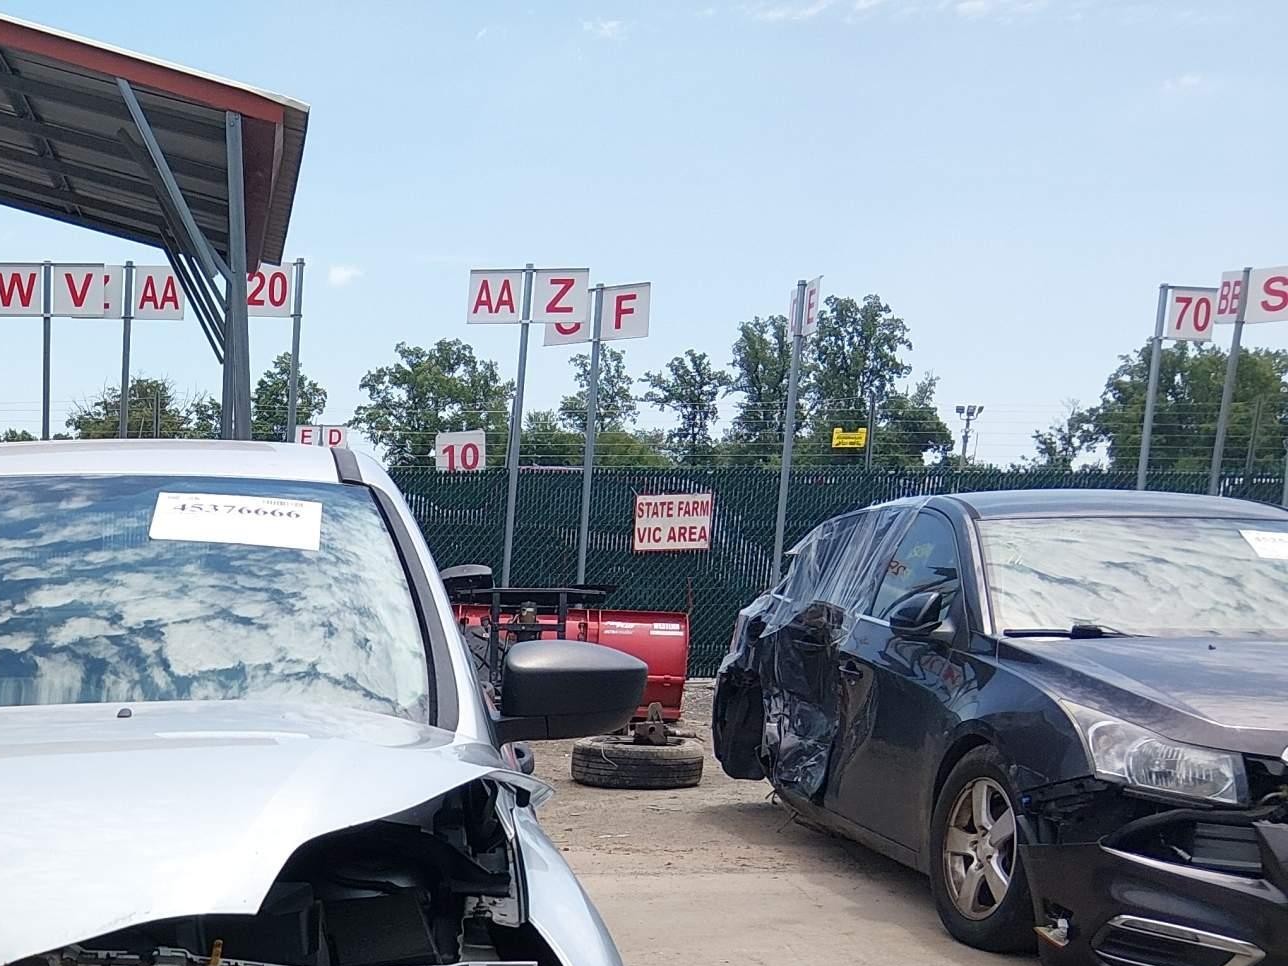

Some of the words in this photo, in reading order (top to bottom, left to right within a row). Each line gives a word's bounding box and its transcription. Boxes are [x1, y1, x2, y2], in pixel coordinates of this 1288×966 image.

[65, 272, 93, 308] V
[139, 275, 179, 310] AA
[247, 271, 289, 307] 20
[472, 279, 515, 314] AA
[546, 278, 575, 313] Z
[1261, 276, 1288, 312] S
[614, 293, 637, 329] F
[1175, 296, 1212, 332] 70
[442, 443, 480, 471] 10
[173, 502, 302, 519] 45376666
[636, 500, 674, 519] STATE
[677, 500, 711, 517] FARM
[636, 527, 662, 544] VIC
[666, 525, 708, 543] AREA
